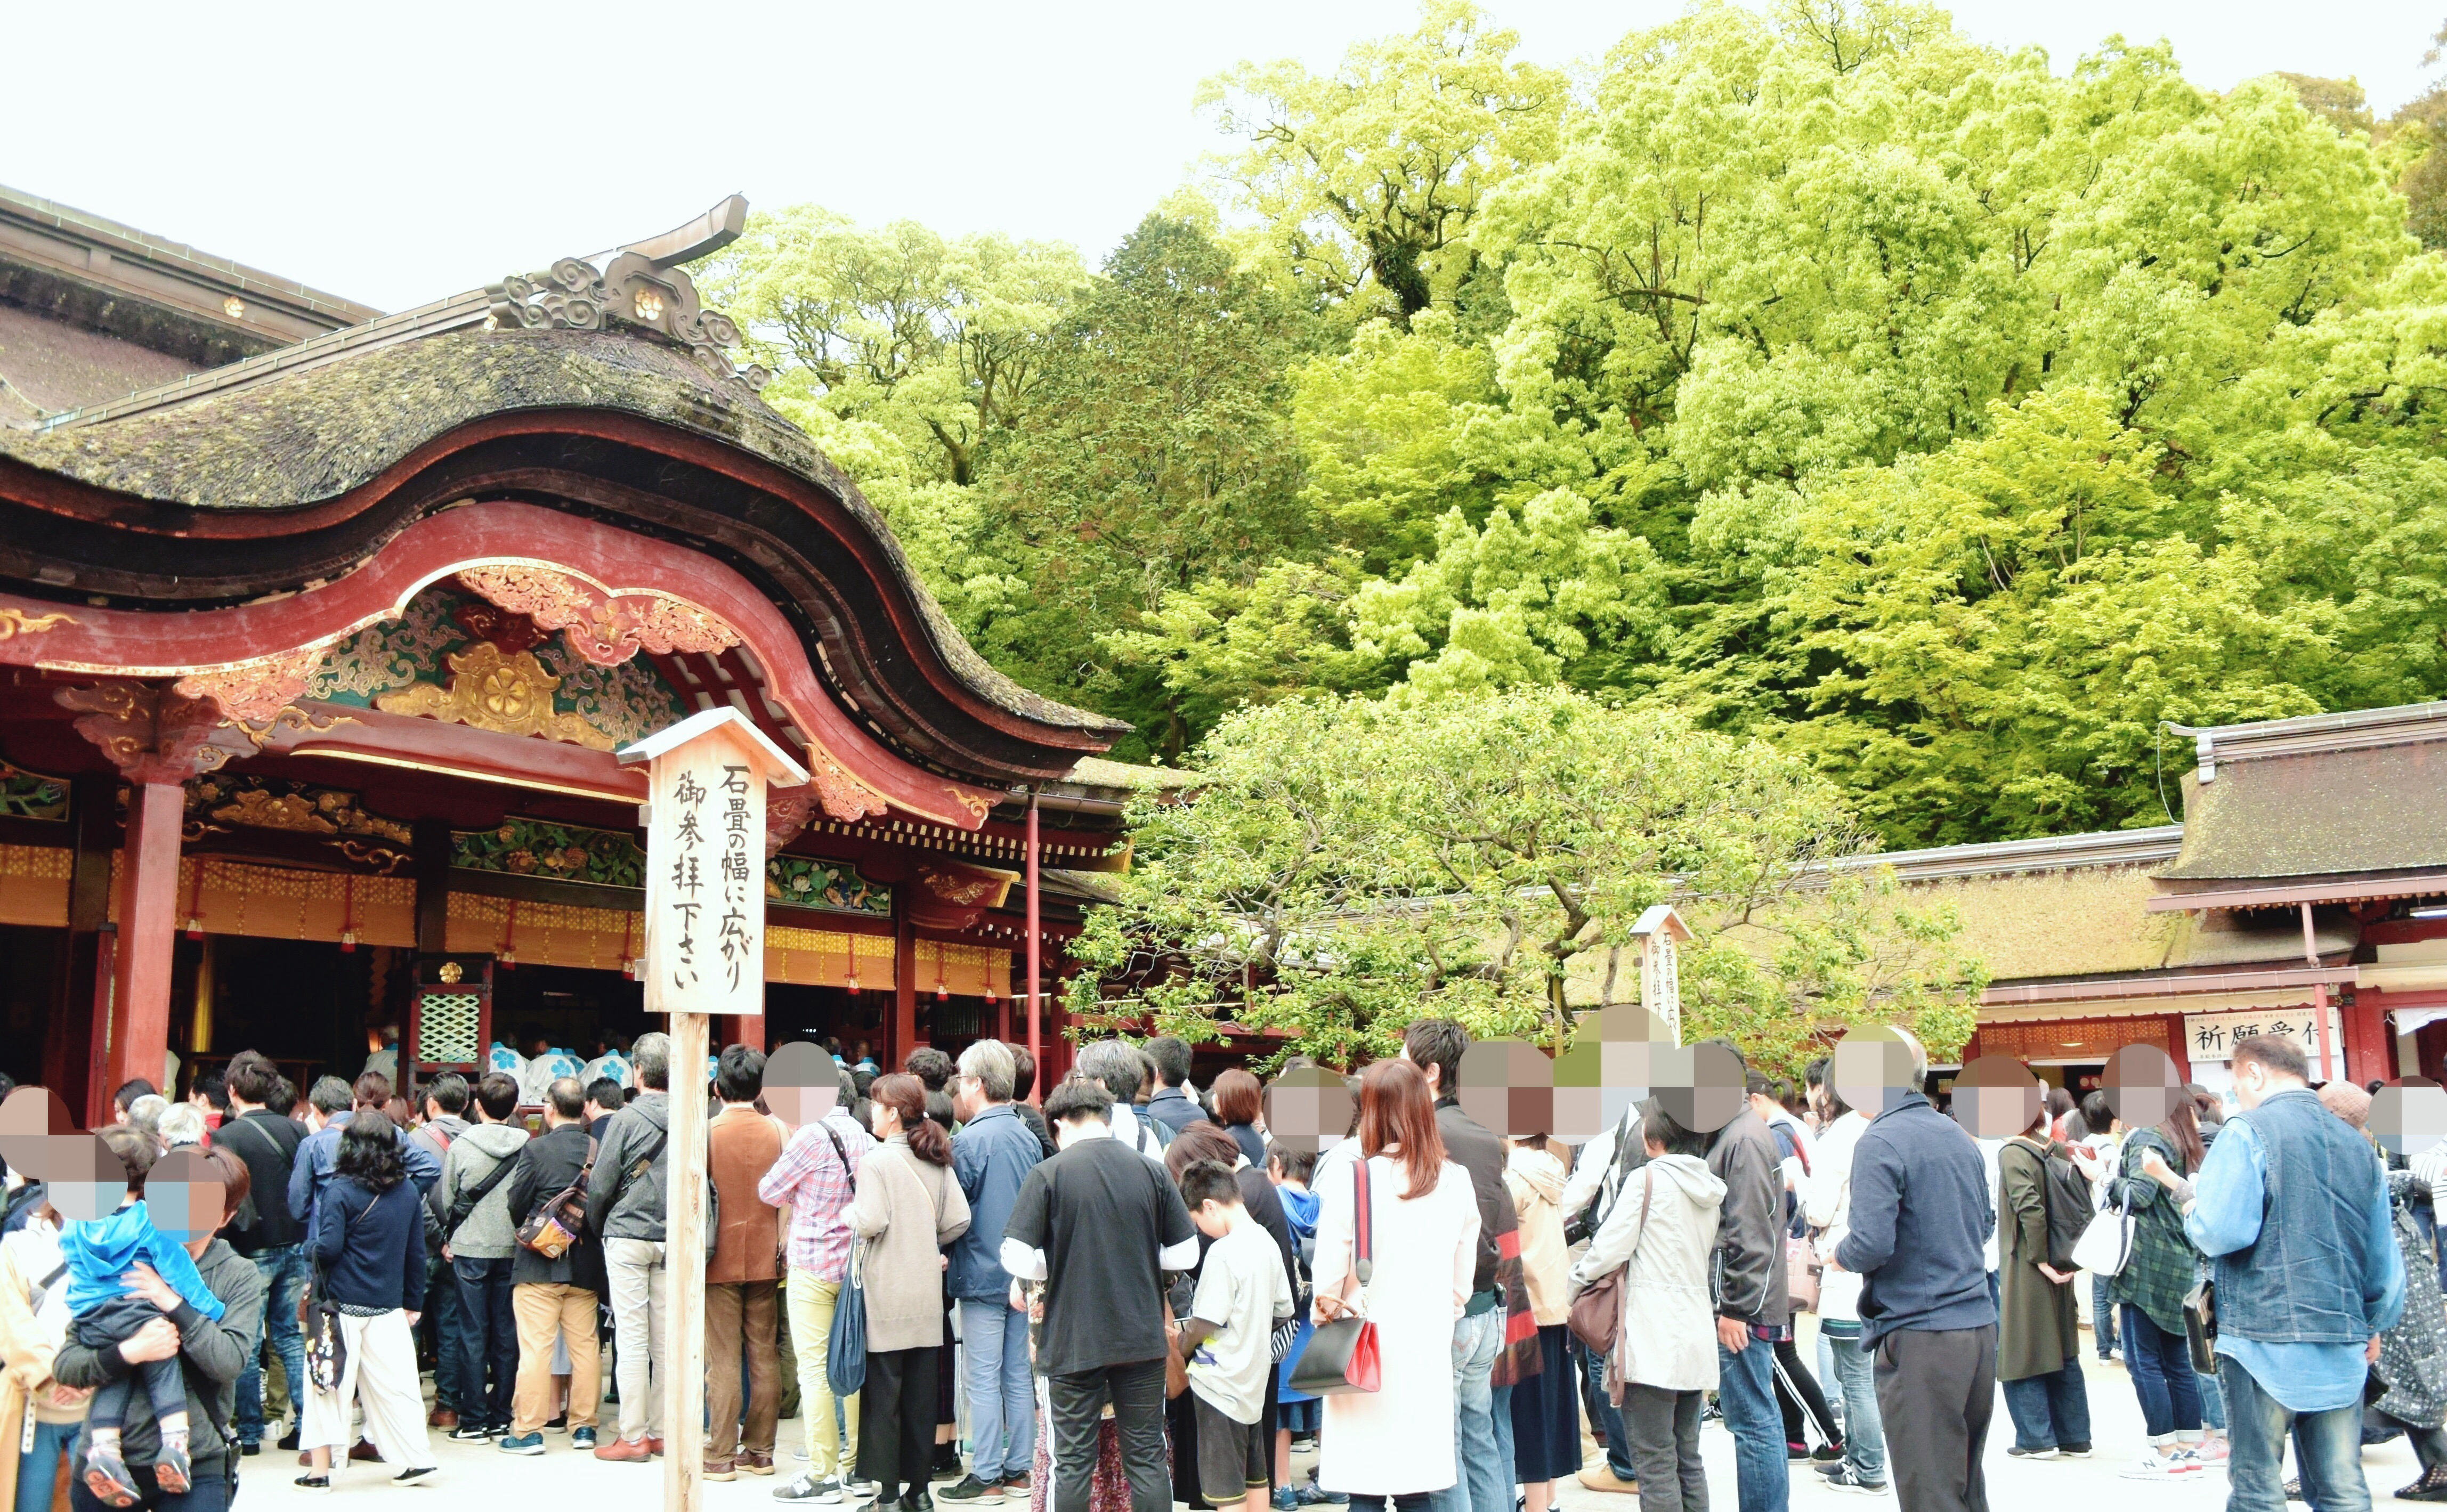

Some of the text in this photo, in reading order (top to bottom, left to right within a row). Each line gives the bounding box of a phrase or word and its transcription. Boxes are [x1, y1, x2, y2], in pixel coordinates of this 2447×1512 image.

[671, 769, 707, 990] 御参拝下さい
[718, 764, 752, 994] 石畳の幅に広がり
